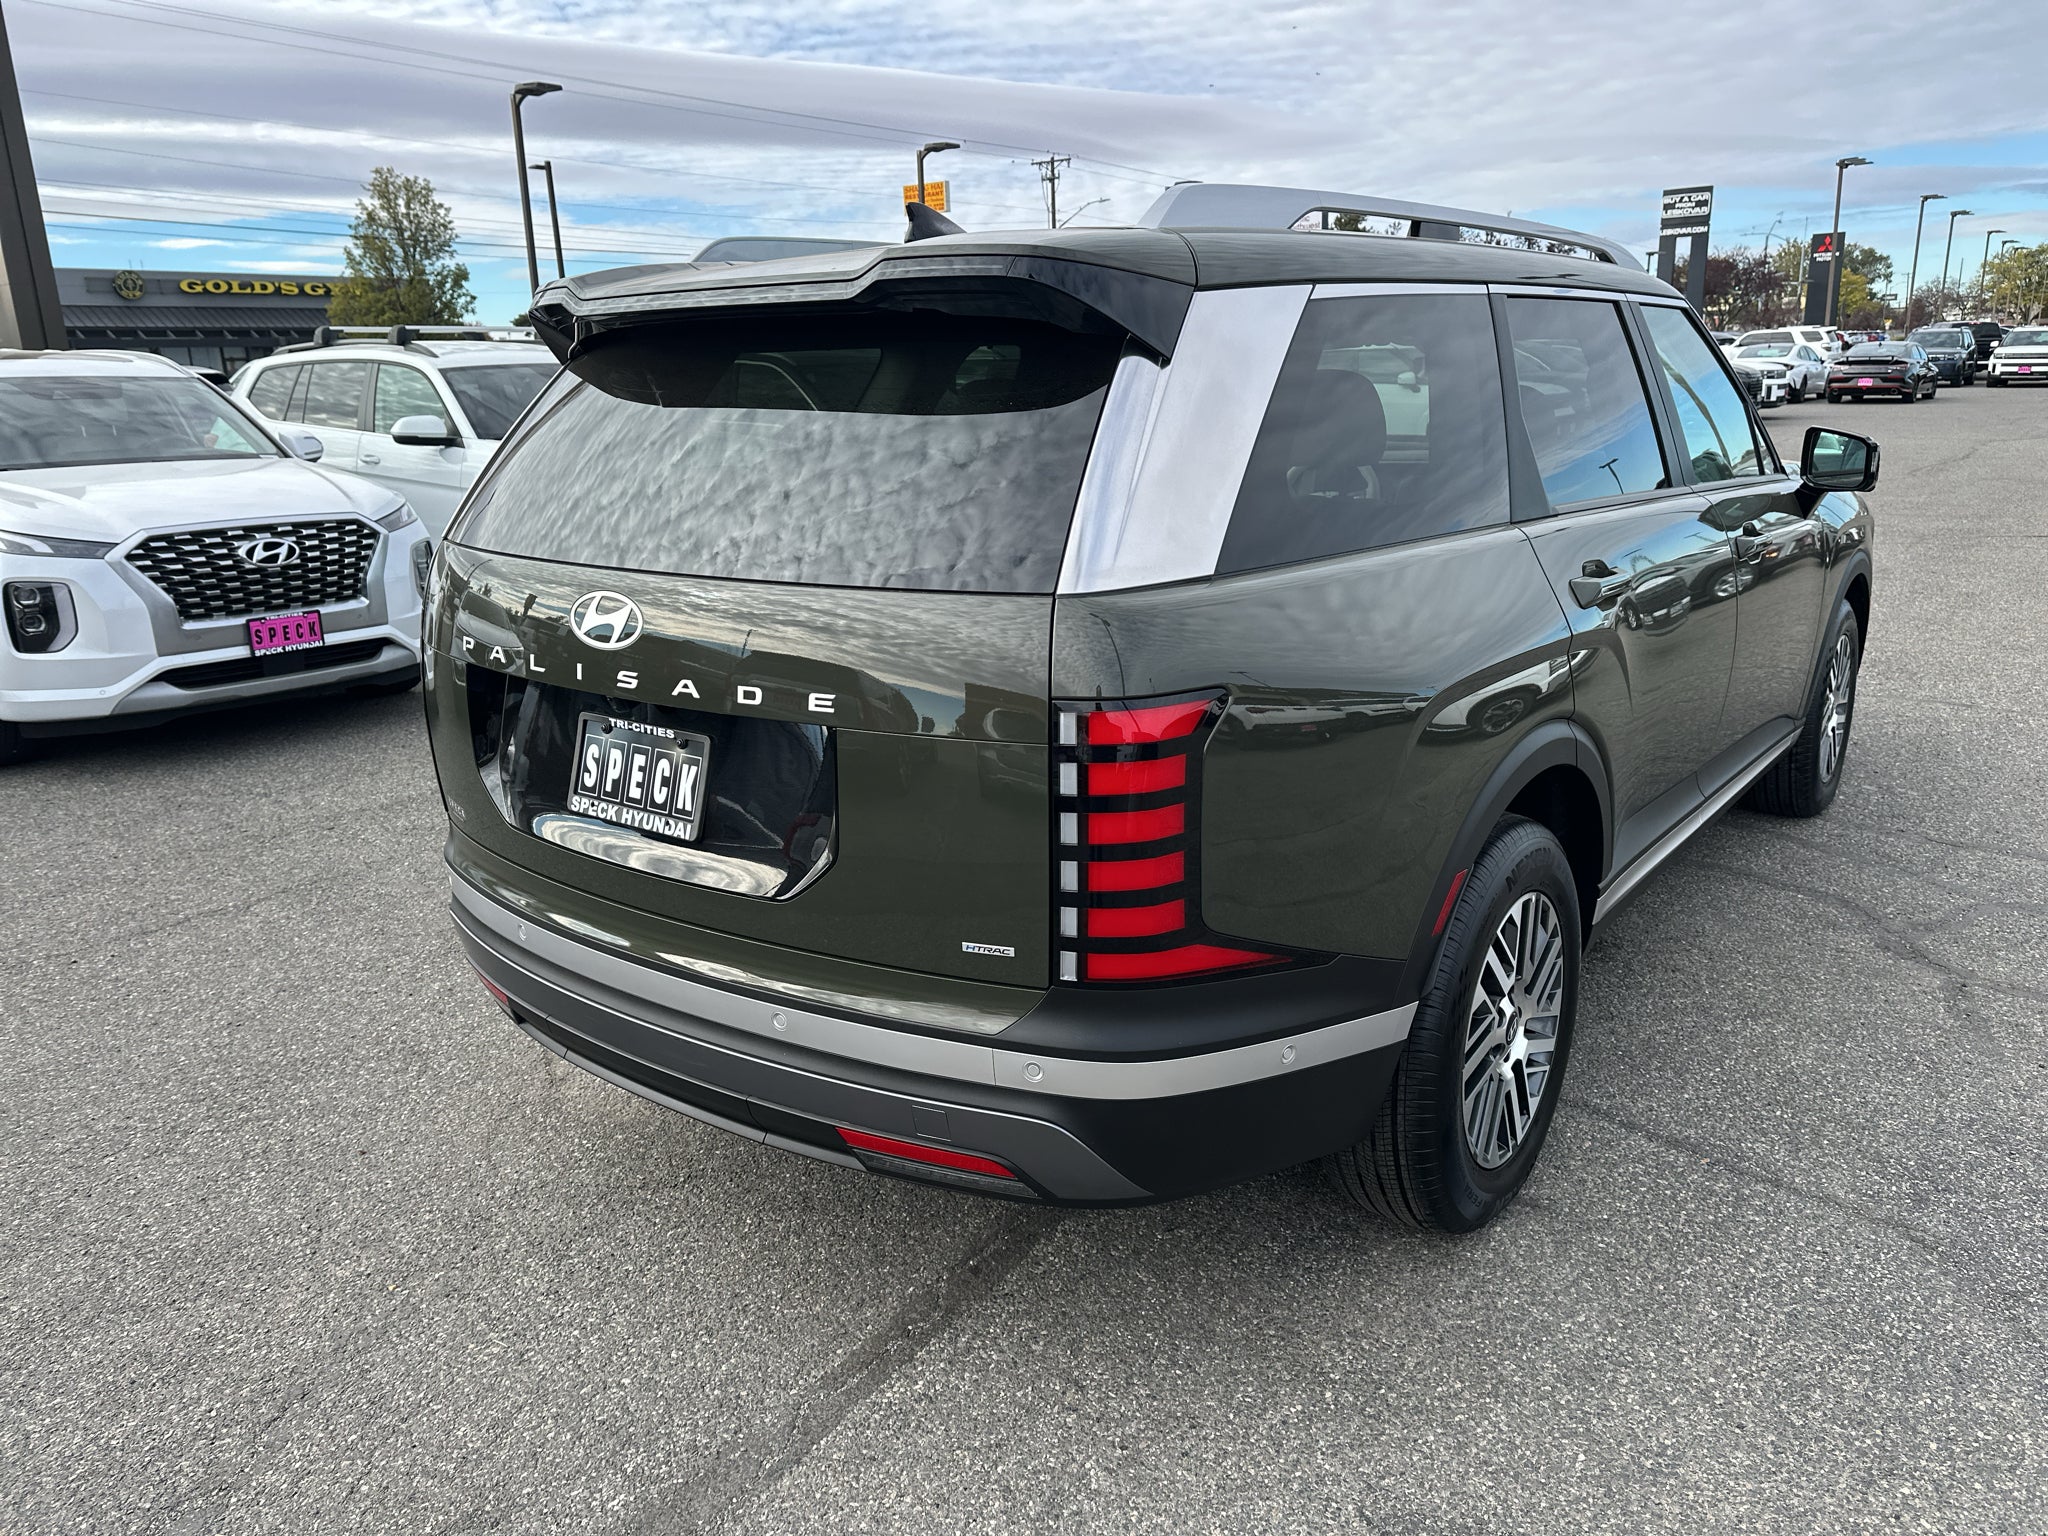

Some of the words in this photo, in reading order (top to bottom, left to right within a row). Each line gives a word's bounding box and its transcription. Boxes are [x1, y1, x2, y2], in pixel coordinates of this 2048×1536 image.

[1663, 196, 1681, 204] BUY
[1662, 206, 1708, 216] LESKOVAR
[179, 279, 299, 295] GOLD'S
[254, 621, 318, 645] SPECK
[254, 646, 284, 657] SPECK
[285, 640, 323, 652] HYUNDAI
[462, 636, 836, 713] PALISADE
[608, 717, 675, 739] TRI-CITIES
[583, 744, 698, 812] SPECK
[570, 796, 619, 822] SPECK
[621, 808, 692, 840] HYUNDAI
[965, 944, 1011, 956] HTRAC
